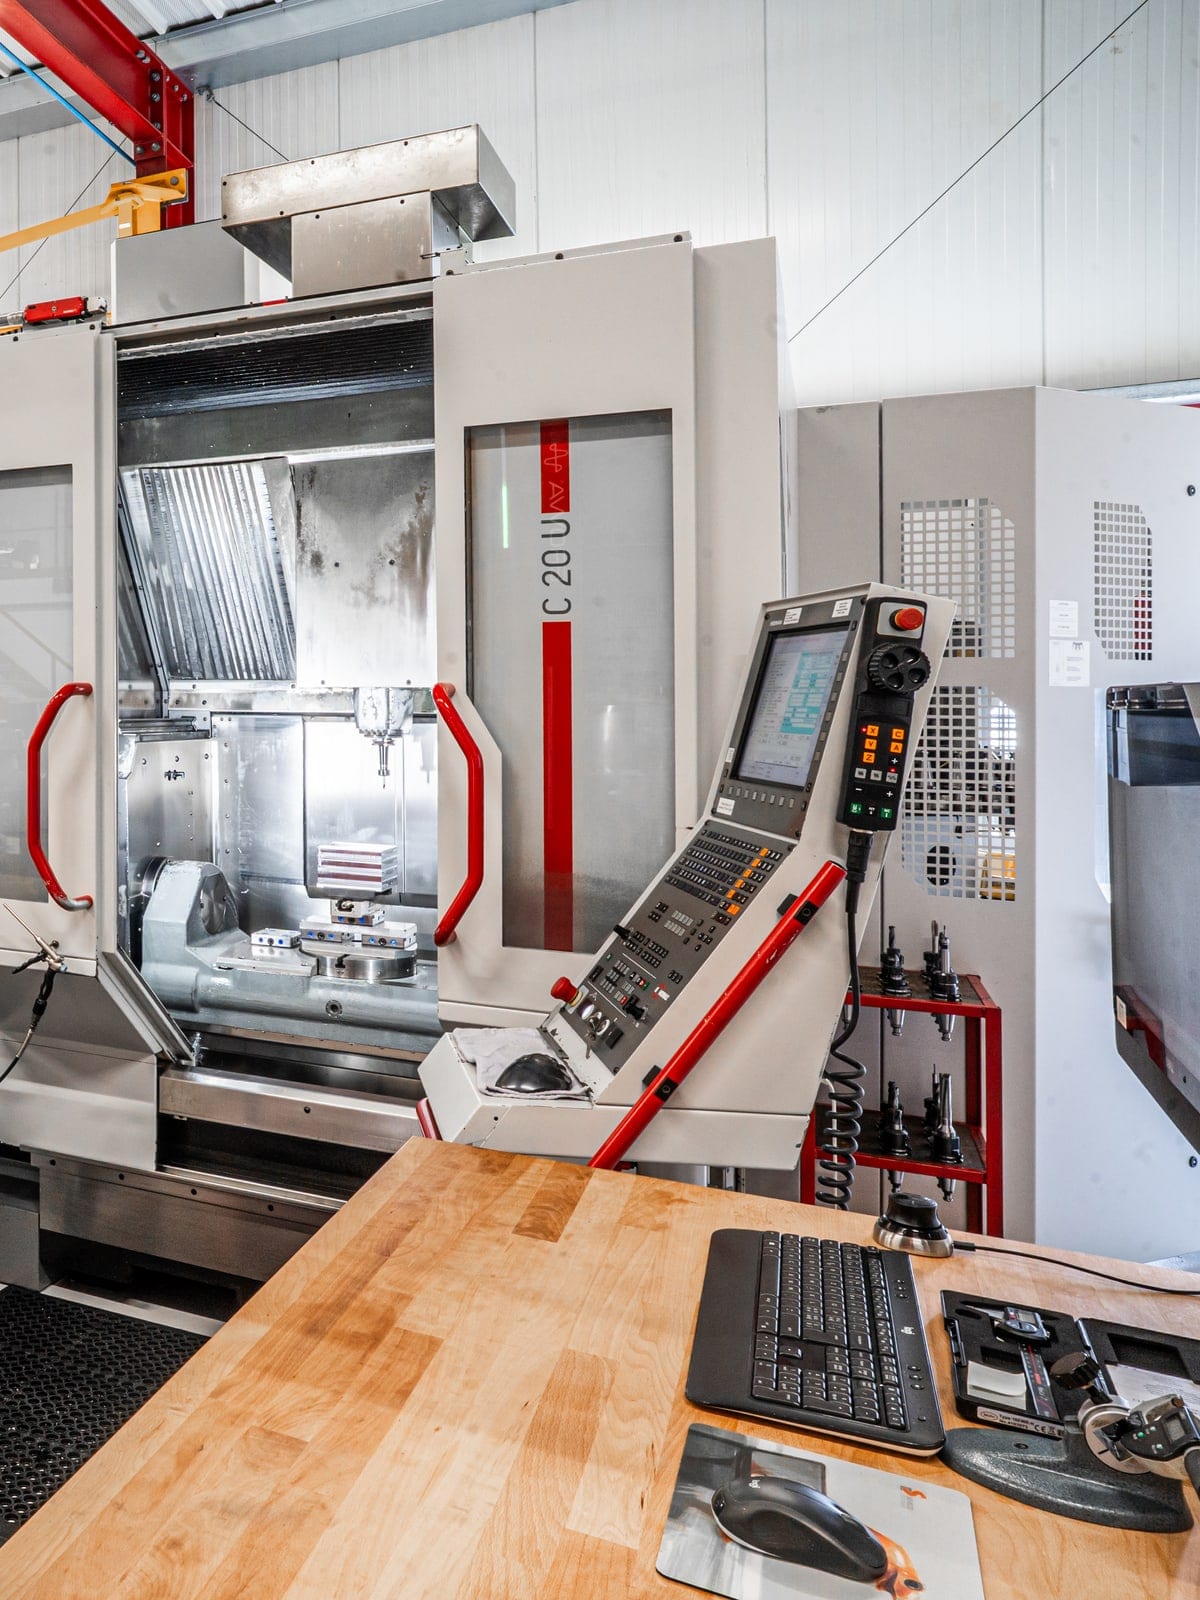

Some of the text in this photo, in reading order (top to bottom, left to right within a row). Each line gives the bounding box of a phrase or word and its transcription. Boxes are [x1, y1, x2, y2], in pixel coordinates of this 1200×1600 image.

[540, 518, 571, 538] U
[541, 549, 572, 587] 20
[541, 598, 572, 616] C
